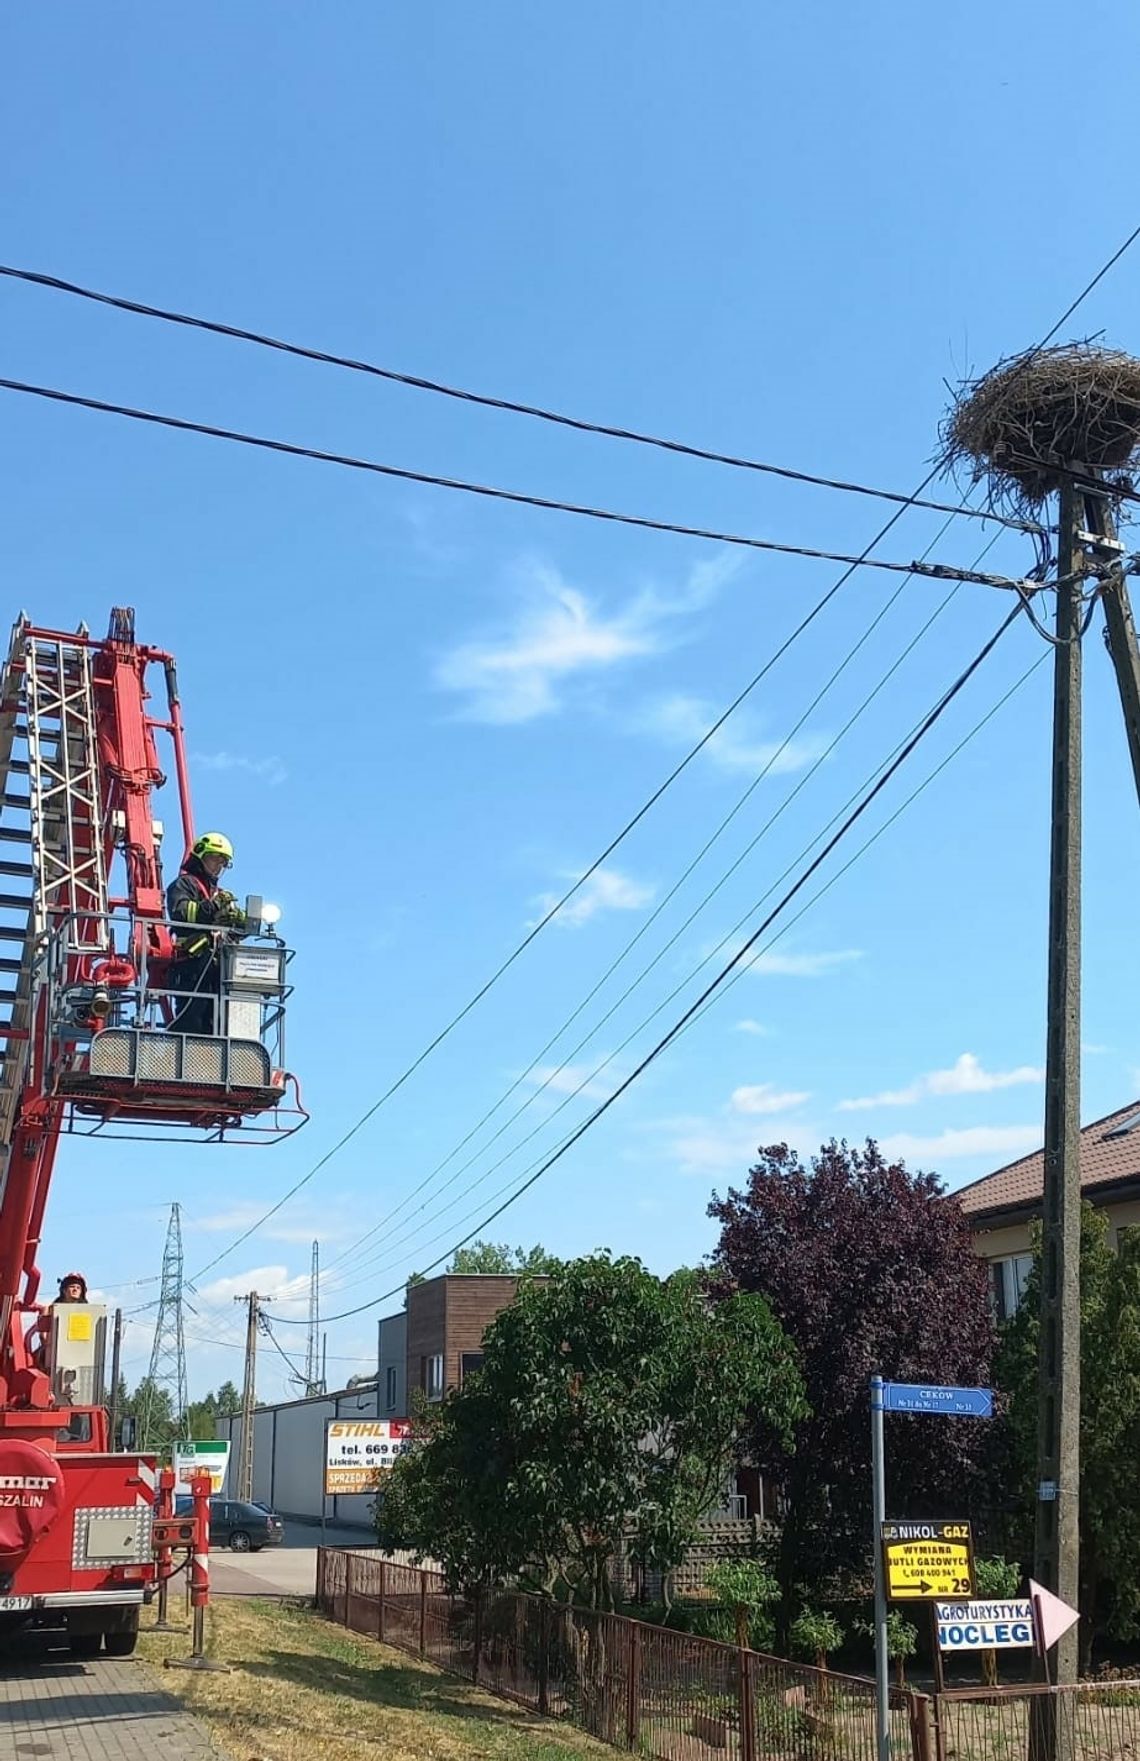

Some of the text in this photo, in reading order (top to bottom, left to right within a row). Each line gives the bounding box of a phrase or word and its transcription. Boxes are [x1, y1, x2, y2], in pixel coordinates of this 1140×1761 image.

[330, 1424, 385, 1437] STIHL
[341, 1444, 362, 1454] tel.
[366, 1444, 388, 1454] 669
[329, 1473, 376, 1484] SPRZEDA
[899, 1526, 968, 1538] NIKOL-GAZ
[903, 1546, 952, 1554] WYMIANA
[952, 1578, 970, 1592] 29
[1, 1597, 30, 1609] 4917
